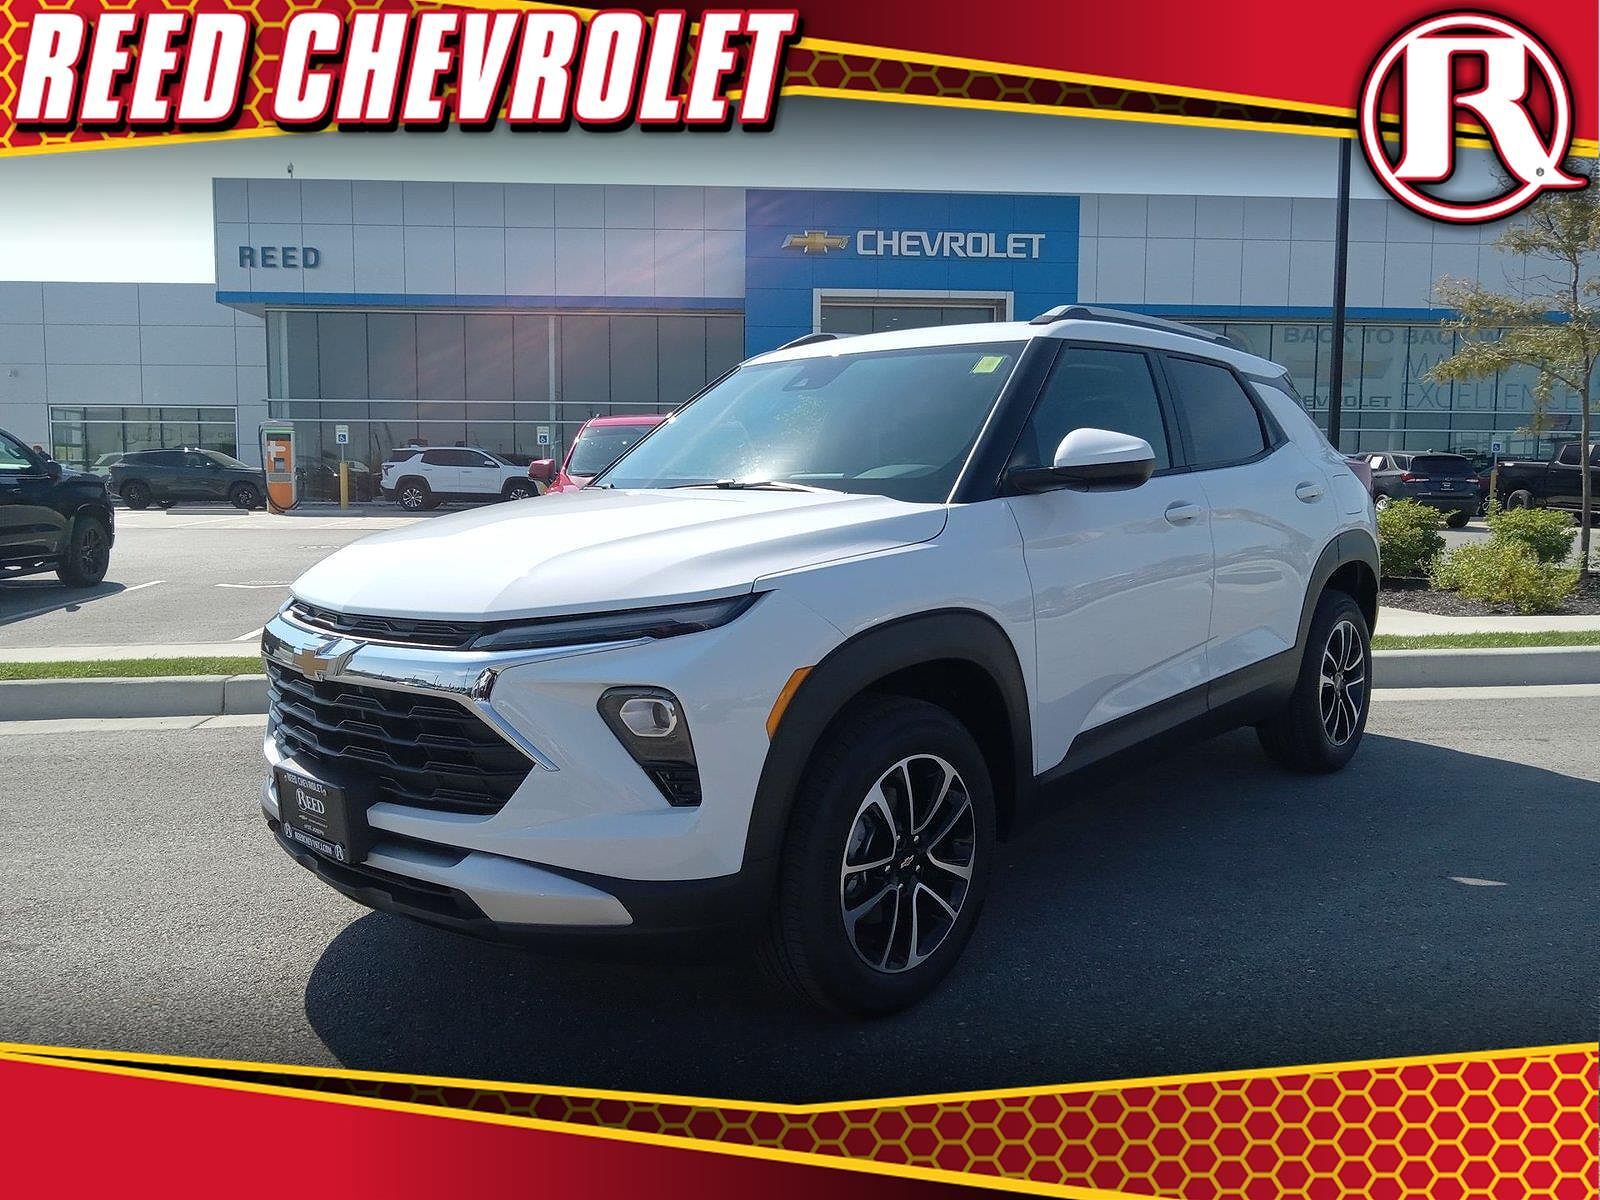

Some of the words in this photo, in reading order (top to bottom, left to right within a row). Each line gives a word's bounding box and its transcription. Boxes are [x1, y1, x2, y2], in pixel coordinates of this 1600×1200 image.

[238, 245, 322, 269] REED
[856, 230, 1046, 259] CHEVROLET
[1303, 394, 1393, 408] EVOLET
[296, 787, 325, 815] REED
